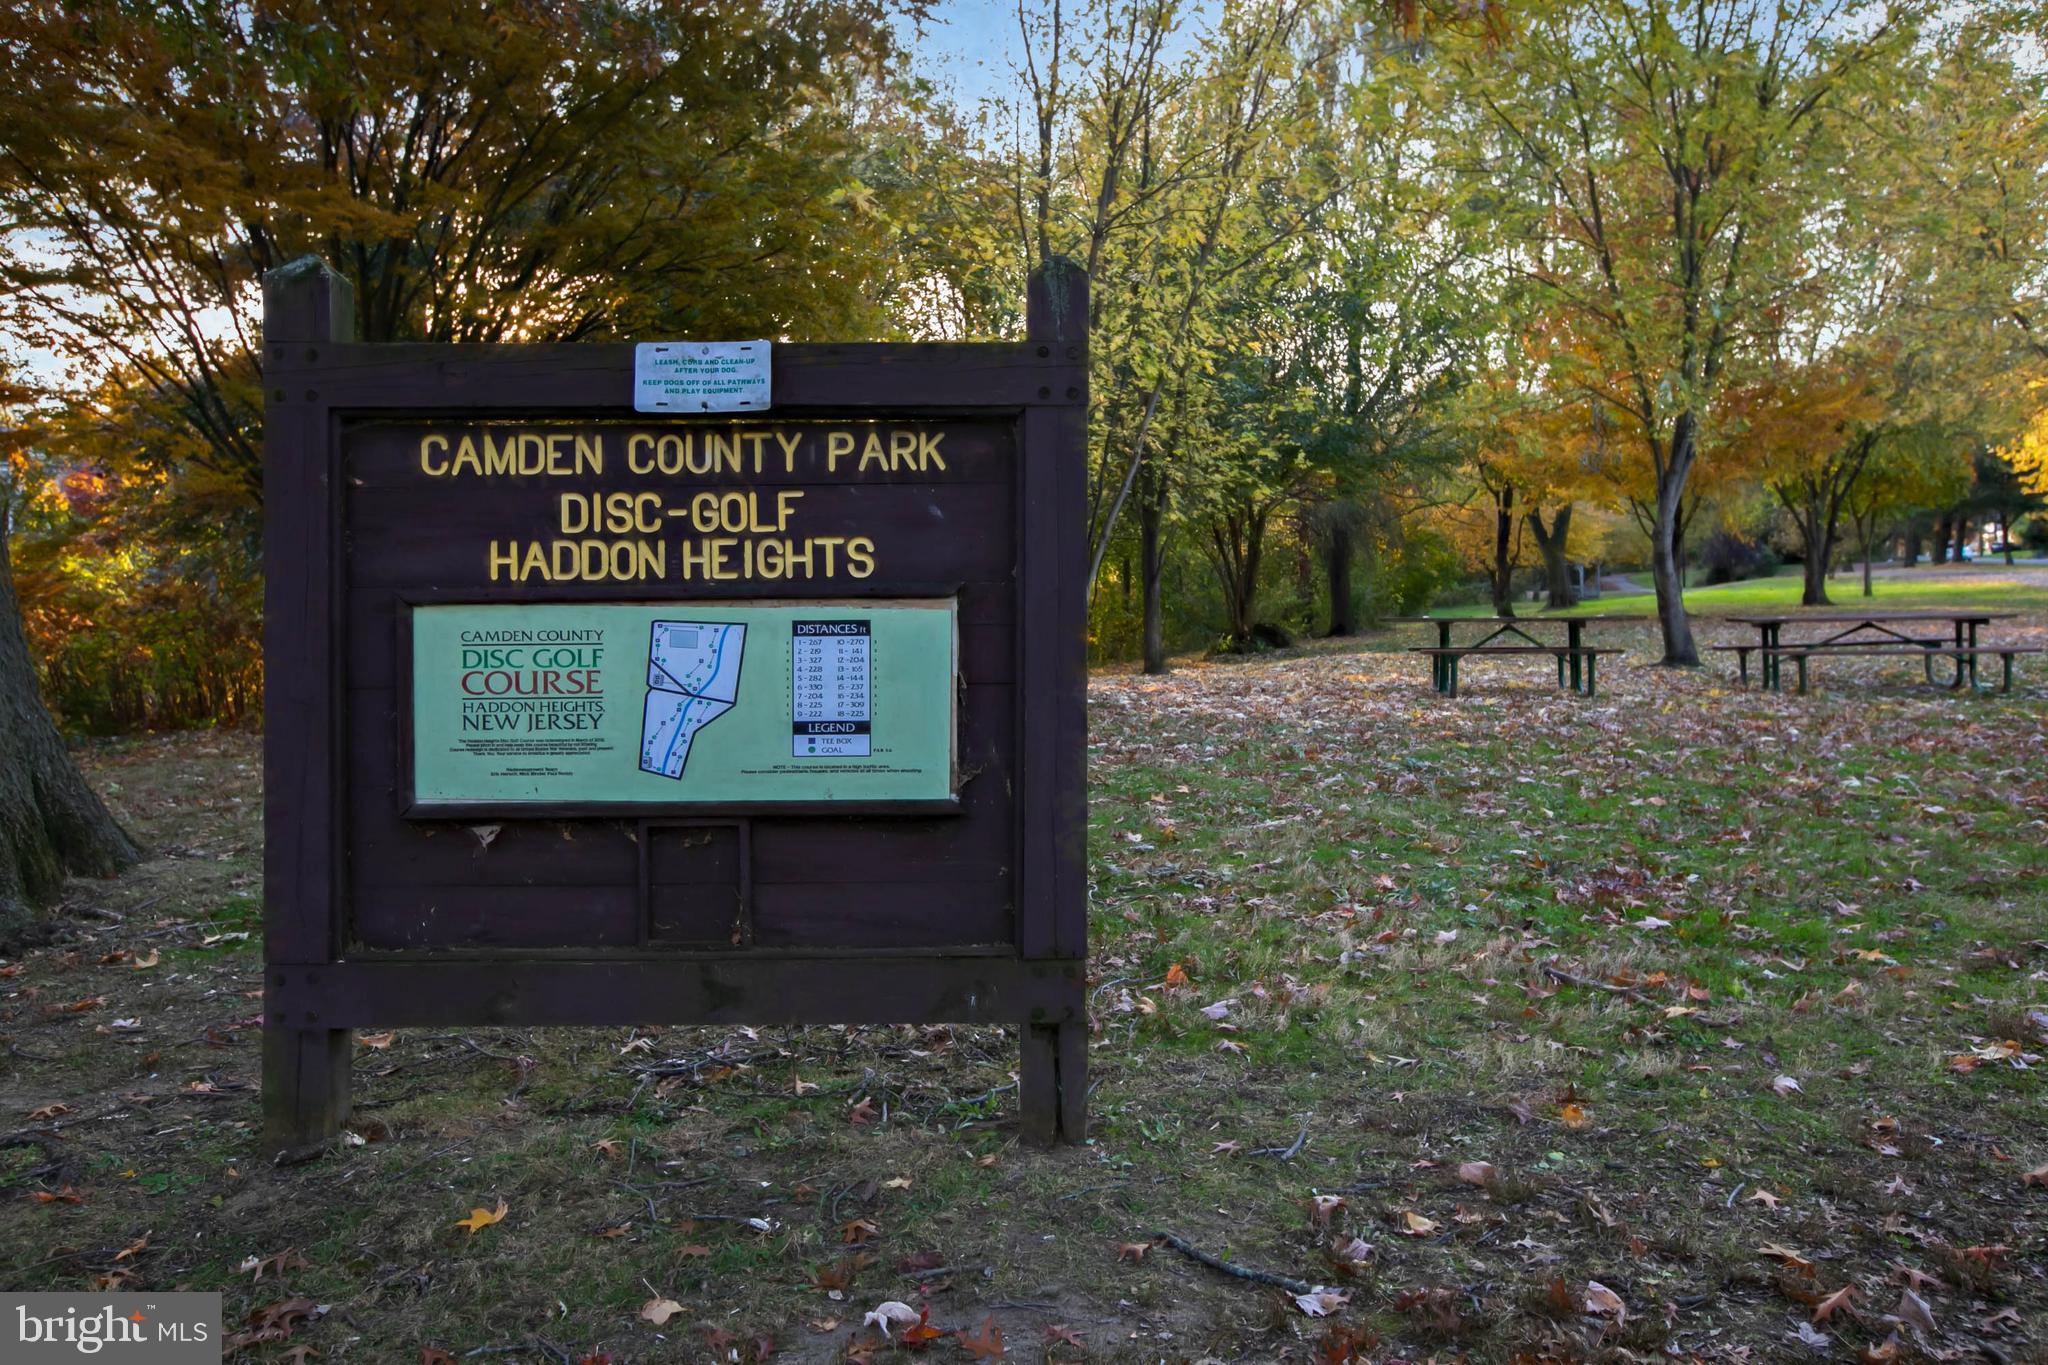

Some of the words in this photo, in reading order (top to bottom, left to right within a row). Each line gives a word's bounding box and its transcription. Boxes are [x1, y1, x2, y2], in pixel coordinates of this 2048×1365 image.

[420, 433, 603, 476] CAMDEN
[627, 432, 803, 475] COUNTY
[827, 432, 946, 473] PARK
[560, 490, 805, 534] DISC-GOLF
[489, 538, 666, 581] HADDON
[682, 536, 875, 580] HEIGHTS
[460, 630, 533, 642] CAMDEN
[537, 630, 604, 642] COUNTY
[797, 624, 858, 634] DISTANCES
[462, 649, 524, 669] DISC
[532, 648, 604, 668] GOLF
[461, 670, 603, 695] COURSE
[463, 701, 536, 713] HADDON
[462, 714, 521, 731] NEW
[527, 713, 603, 732] JERSEY
[808, 723, 855, 732] LEGEND
